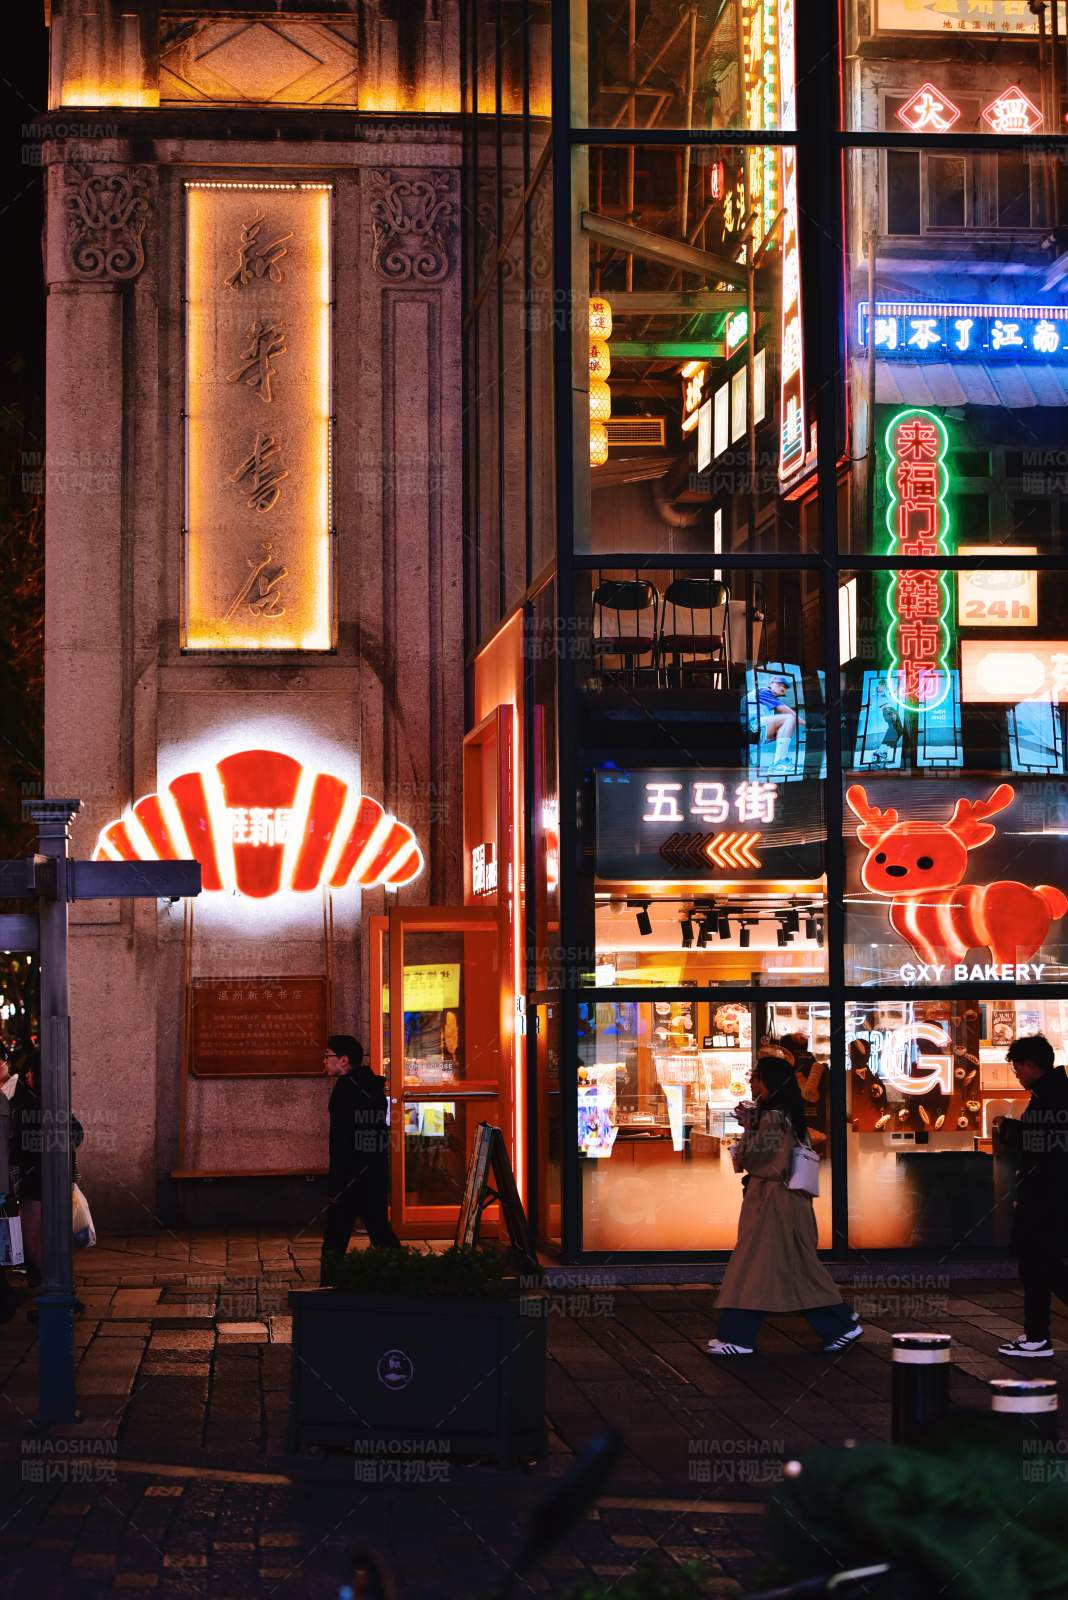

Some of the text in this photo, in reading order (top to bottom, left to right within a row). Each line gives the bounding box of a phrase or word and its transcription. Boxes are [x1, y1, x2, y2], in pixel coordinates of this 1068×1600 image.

[897, 420, 940, 702] 来福门皮鞋市场
[965, 600, 1030, 618] 24h
[641, 780, 778, 824] 五马街
[899, 962, 946, 984] GXY
[954, 963, 1046, 981] BAKERY
